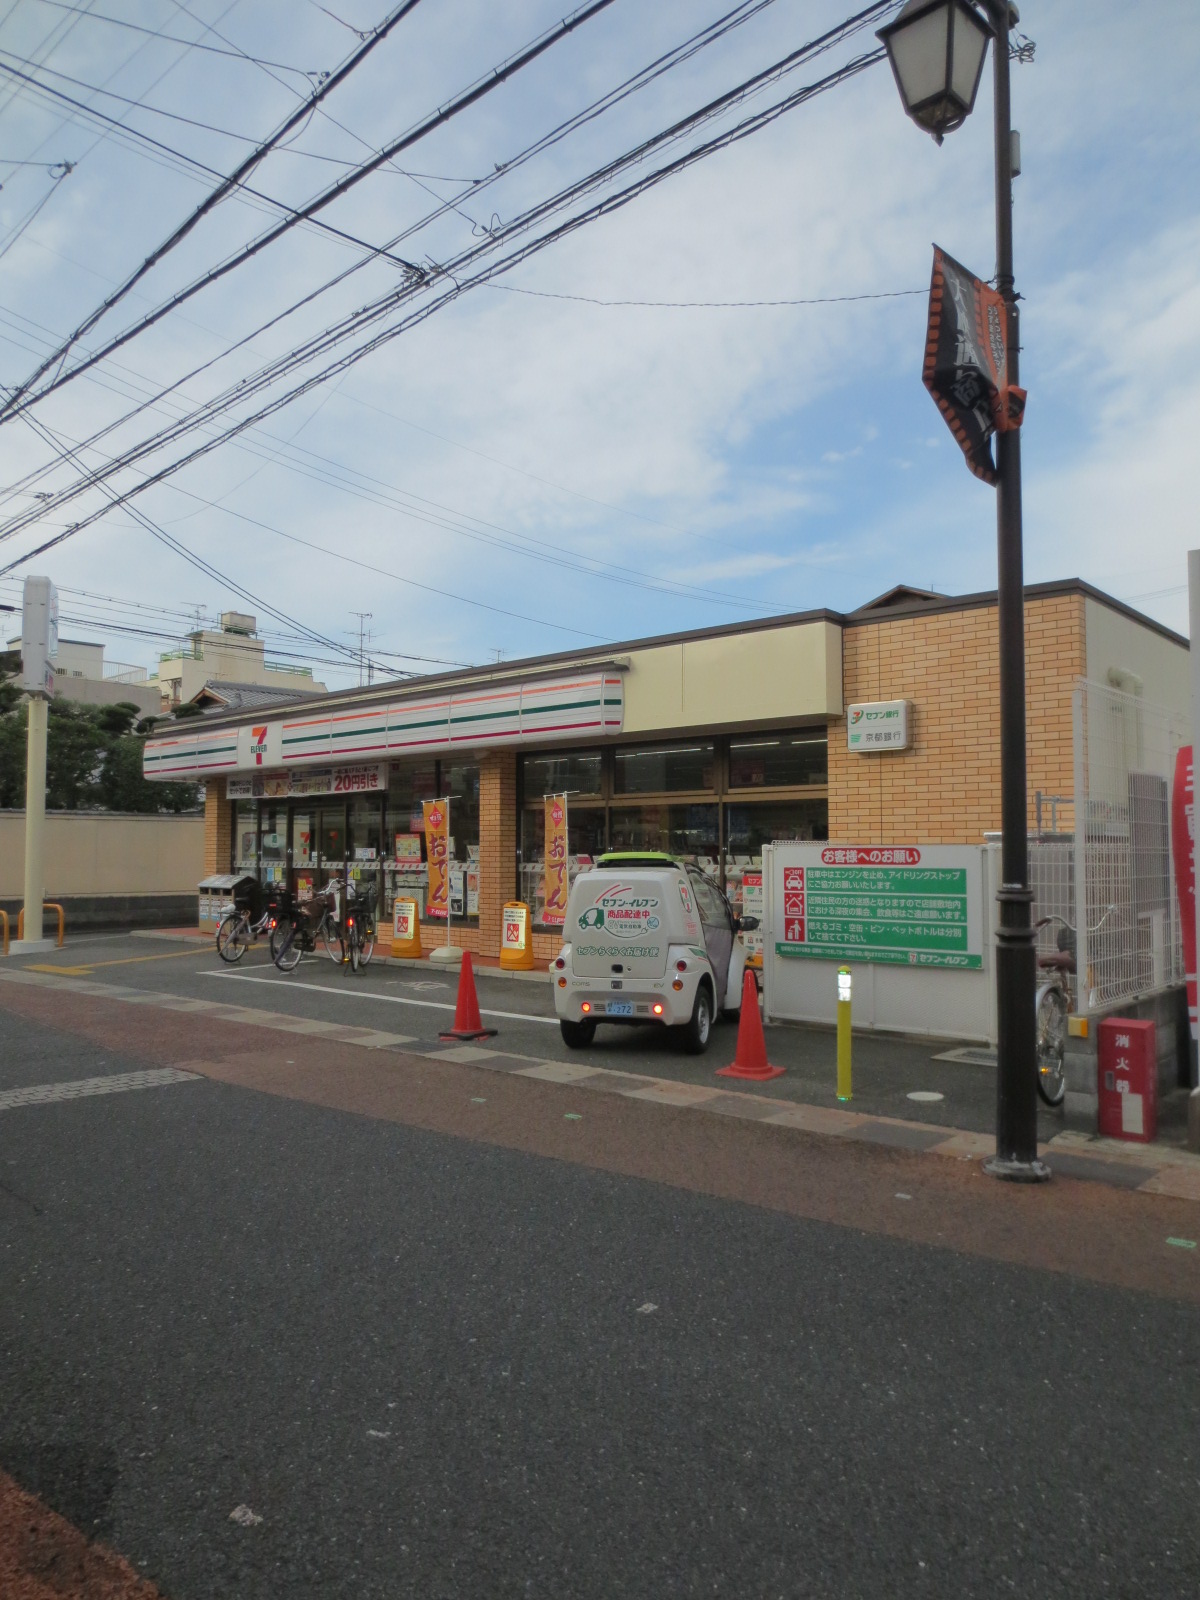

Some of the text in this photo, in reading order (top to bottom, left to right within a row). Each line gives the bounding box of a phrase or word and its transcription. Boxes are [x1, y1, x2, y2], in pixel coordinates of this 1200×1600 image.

[866, 710, 900, 720] セブン銀行
[866, 730, 902, 742] 京都銀行
[334, 772, 378, 792] 20円引き
[823, 848, 919, 864] お客様へのお願い
[429, 833, 448, 904] おでん
[546, 835, 568, 910] おでん
[808, 880, 895, 890] にご協力お願いいたします。
[607, 909, 651, 919] 商品配達中
[809, 932, 867, 943] して捨てて下さい。
[577, 946, 660, 957] セブンらくらくお届け便
[1116, 1034, 1130, 1093] 消火器
